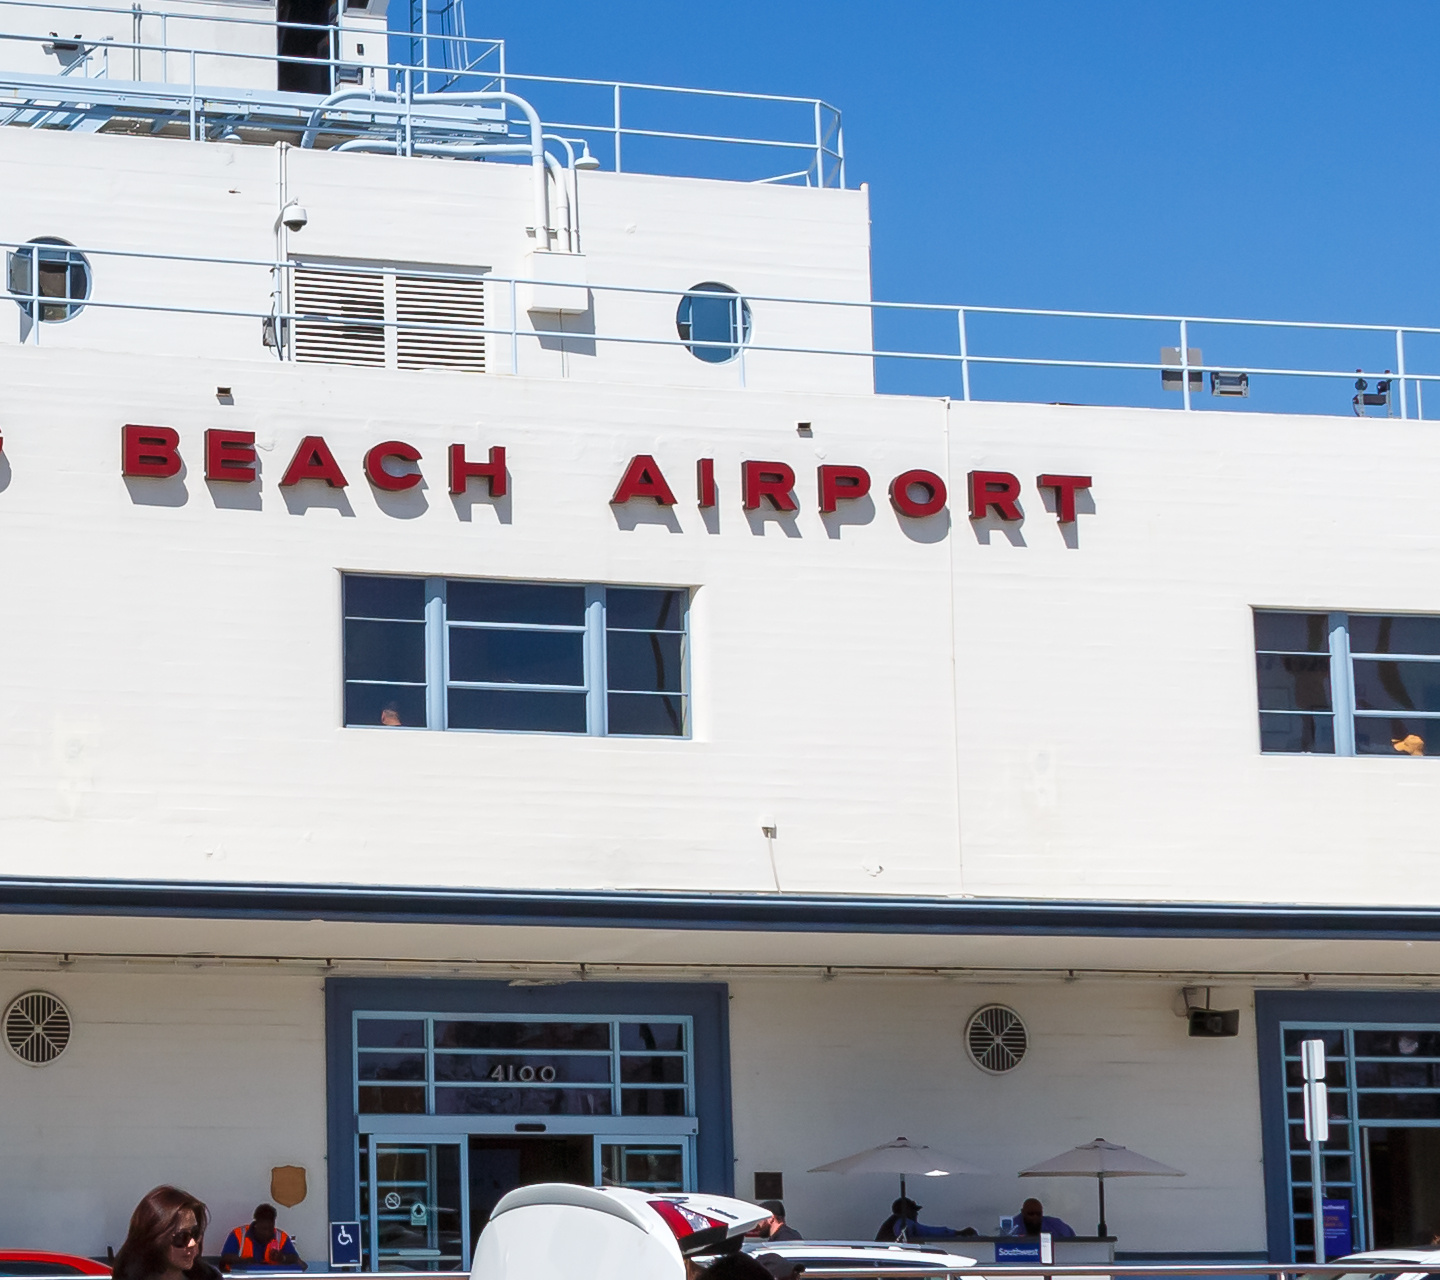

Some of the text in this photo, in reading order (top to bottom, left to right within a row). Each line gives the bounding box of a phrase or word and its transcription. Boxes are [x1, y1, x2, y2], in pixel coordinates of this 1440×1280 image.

[121, 424, 508, 497] BEACH
[610, 455, 1093, 523] AIRPORT
[491, 1064, 556, 1082] 4100
[998, 1247, 1039, 1256] Southwest
